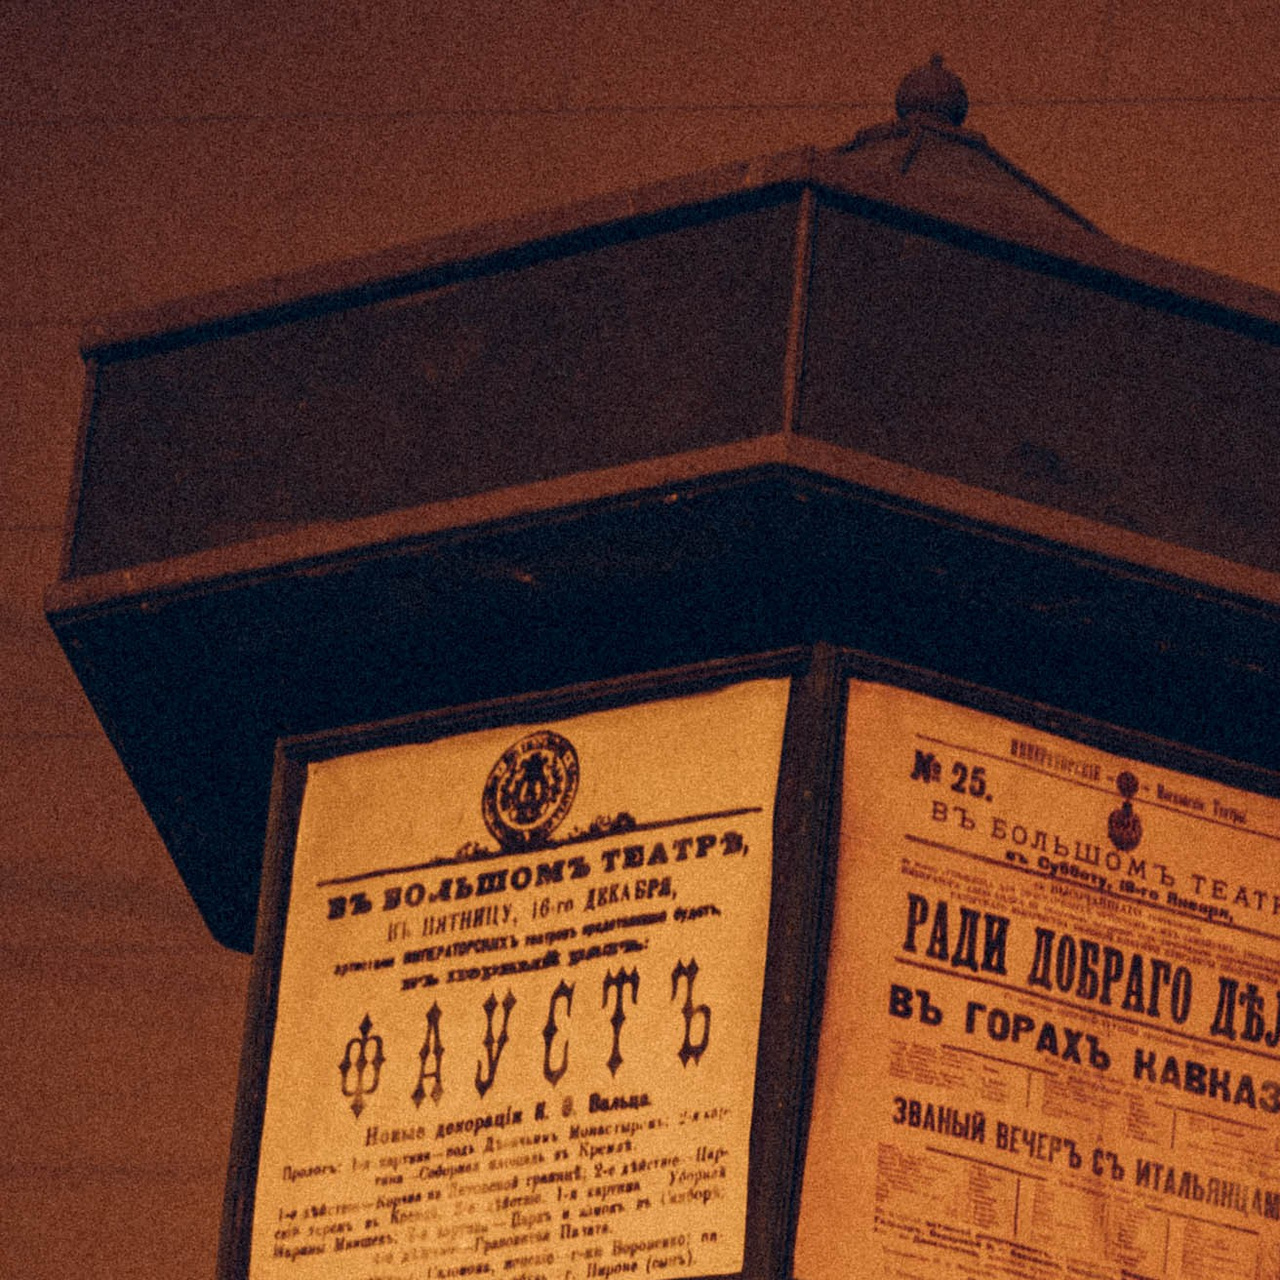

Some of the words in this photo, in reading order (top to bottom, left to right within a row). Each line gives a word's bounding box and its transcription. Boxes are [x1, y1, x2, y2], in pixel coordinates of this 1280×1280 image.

[909, 747, 943, 787] №
[949, 758, 995, 803] 25.
[325, 890, 374, 921] ВЪ
[382, 853, 592, 912] БОЛЬШОМЪ
[929, 797, 977, 832] ВЪ
[990, 815, 1176, 889] БОЛЬШОМЪ
[901, 890, 1012, 981] РАДИ
[1026, 923, 1195, 1028] ДОБРАГО
[332, 951, 717, 1121] ФАУСТЪ
[887, 980, 946, 1030] ВЪ
[963, 999, 1114, 1073] ГОРАХЪ
[890, 1089, 987, 1148] ЗВАНЫЙ
[994, 1120, 1084, 1171] ВЕЧЕРЪ
[1090, 1144, 1127, 1182] СЪ
